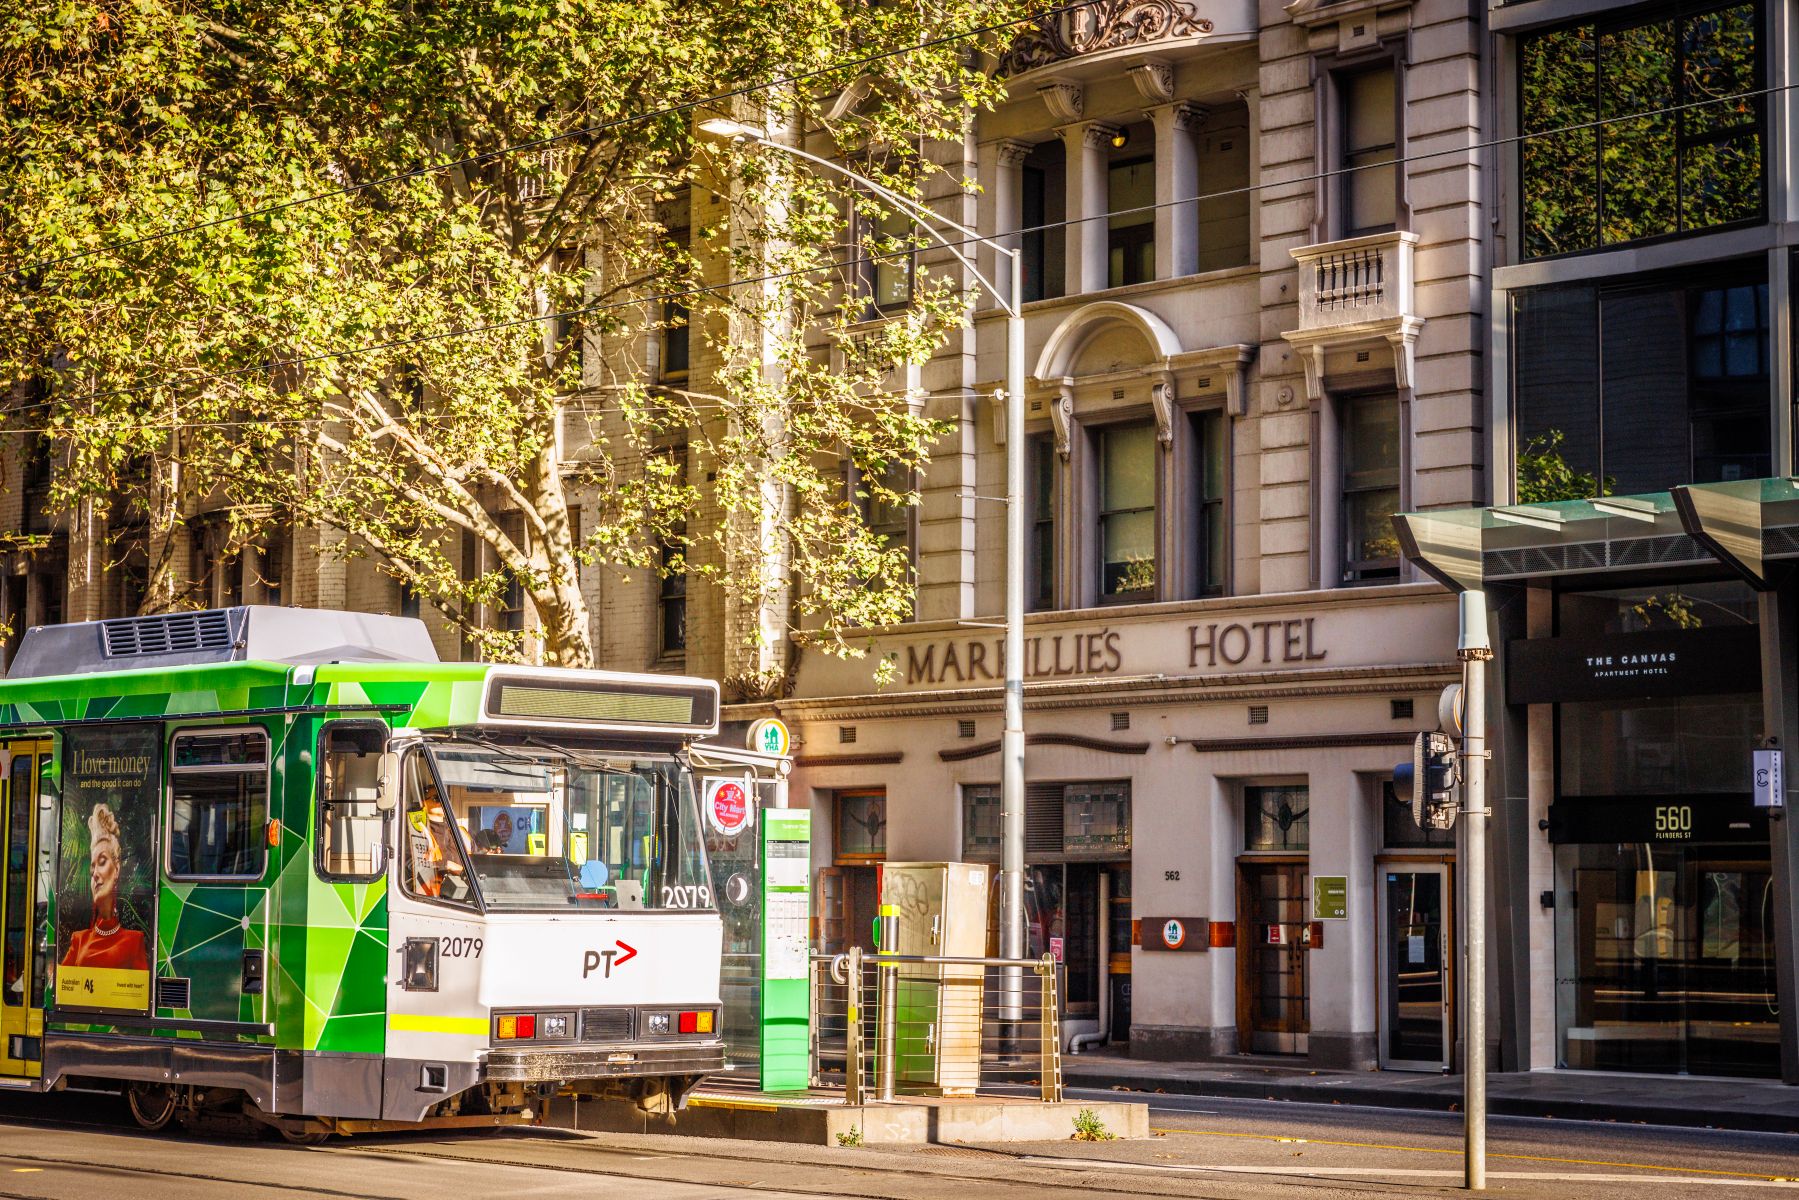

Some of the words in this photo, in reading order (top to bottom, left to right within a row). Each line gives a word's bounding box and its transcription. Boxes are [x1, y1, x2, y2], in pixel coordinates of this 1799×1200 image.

[1187, 617, 1328, 668] HOTEL
[1586, 656, 1613, 666] THE
[1621, 652, 1676, 664] CANVAS
[1594, 669, 1639, 678] APARTMENT
[1643, 667, 1668, 675] HOTEL
[72, 750, 78, 775] I
[80, 749, 105, 775] love
[109, 756, 152, 781] money
[80, 779, 91, 789] and
[92, 779, 101, 788] the
[102, 778, 116, 789] good
[122, 779, 133, 787] can
[133, 778, 141, 787] do
[714, 801, 729, 812] City
[1655, 805, 1692, 831] 560
[1655, 831, 1683, 839] FLINDERS
[1684, 831, 1692, 839] ST
[1164, 870, 1180, 881] 562
[661, 885, 710, 909] 2079
[441, 936, 484, 959] 2079
